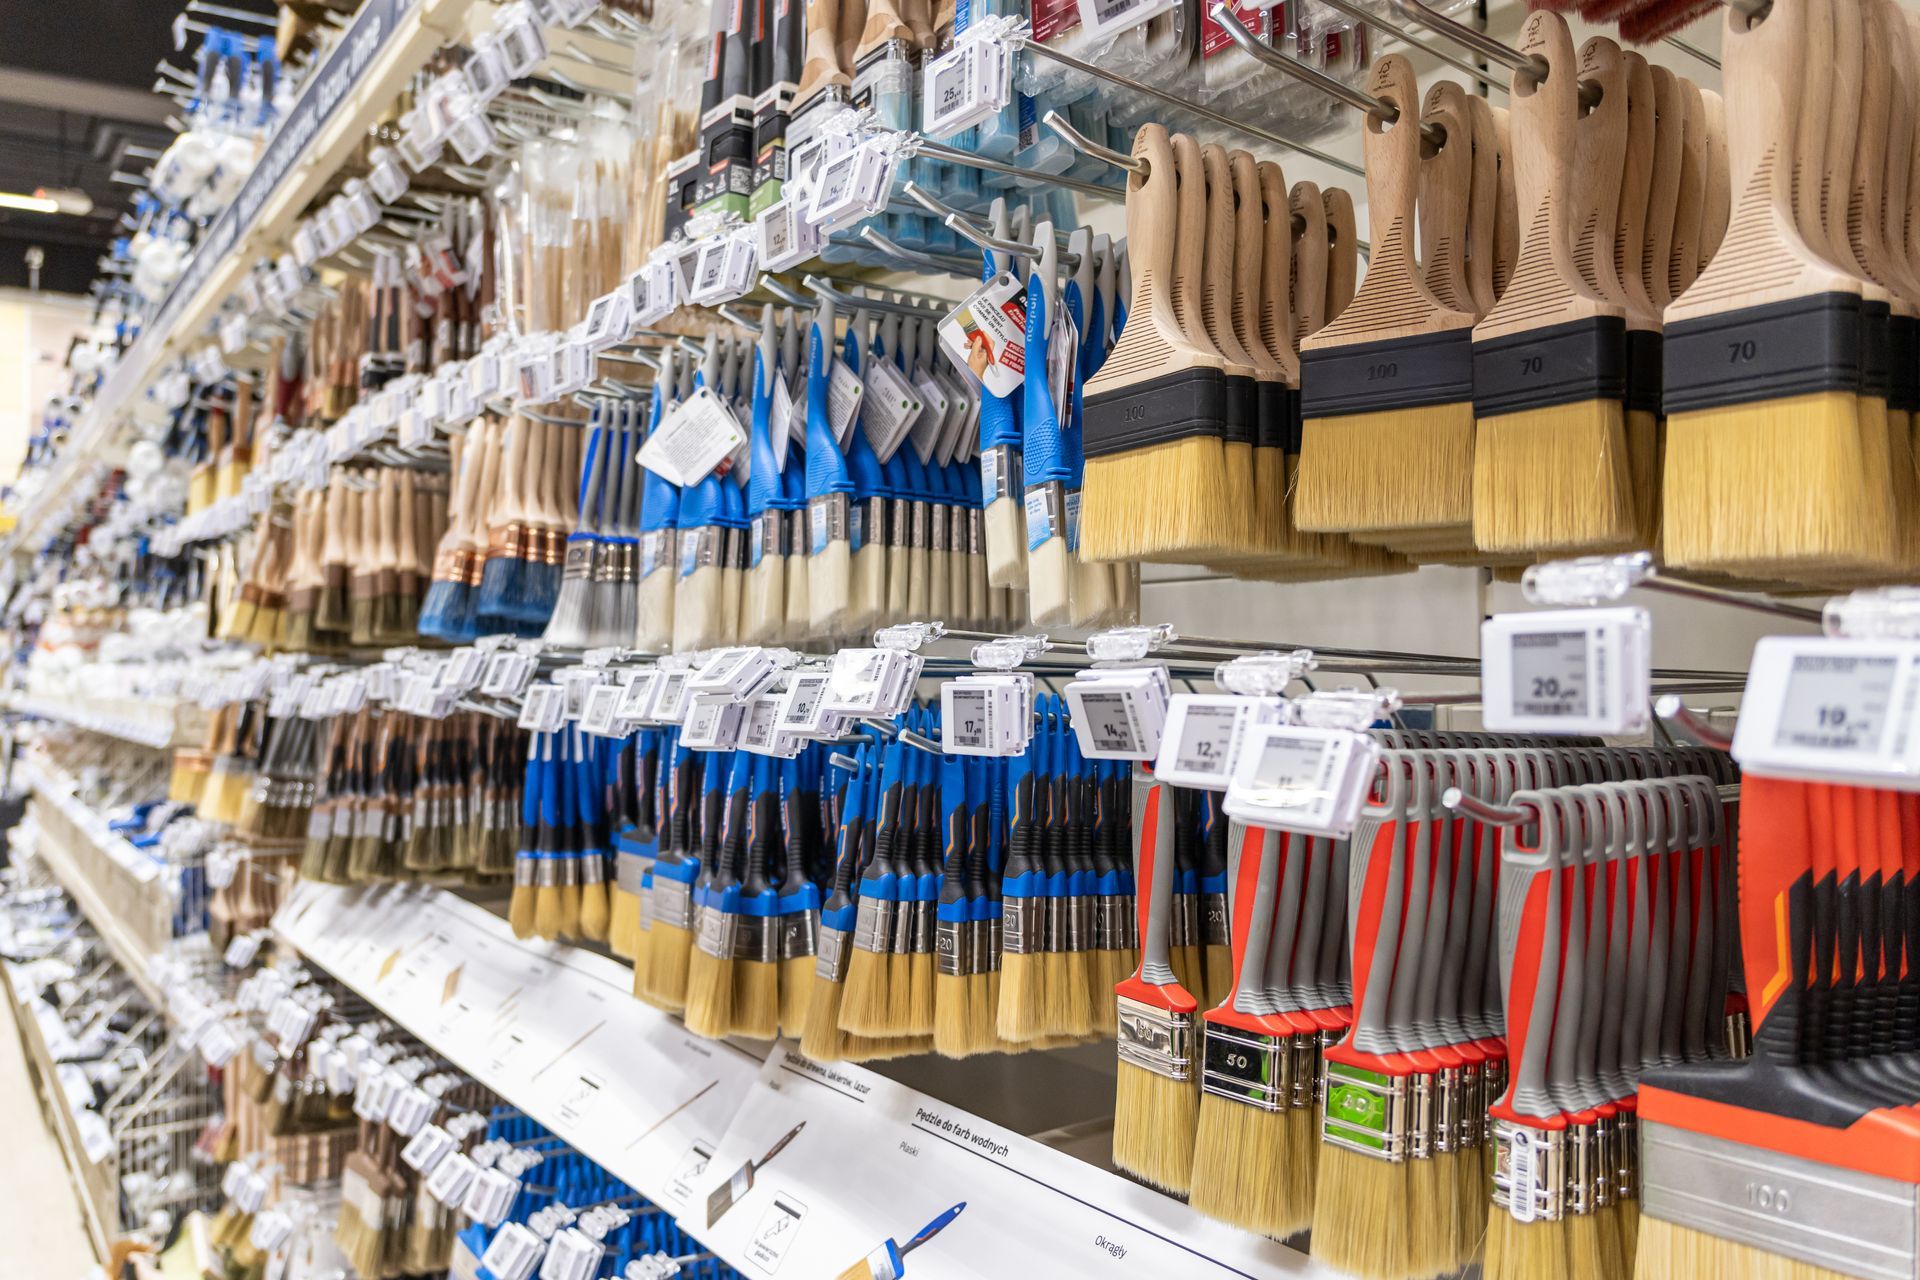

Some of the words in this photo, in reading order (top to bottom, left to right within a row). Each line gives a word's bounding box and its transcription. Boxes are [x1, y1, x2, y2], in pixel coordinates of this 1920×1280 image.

[987, 302, 1006, 323] PINCEAU
[991, 315, 1004, 328] TIENT
[1027, 293, 1038, 342] nespoli
[973, 304, 989, 321] COMME
[994, 328, 1008, 343] STYLO
[1728, 340, 1756, 363] 70
[1367, 363, 1398, 381] 100
[1521, 356, 1543, 375] 70
[1123, 404, 1144, 422] 100
[1004, 913, 1016, 927] 20
[1208, 910, 1223, 923] 20
[939, 937, 953, 950] 20
[1226, 1053, 1247, 1069] 50
[853, 1080, 871, 1094] lazur
[915, 1107, 941, 1127] Pędzle
[941, 1119, 952, 1132] do
[952, 1123, 971, 1140] farb
[971, 1132, 1009, 1157] wodnych
[899, 1140, 920, 1157] Płaski
[1745, 1181, 1792, 1212] 100
[1095, 1235, 1128, 1260] Okrągły
